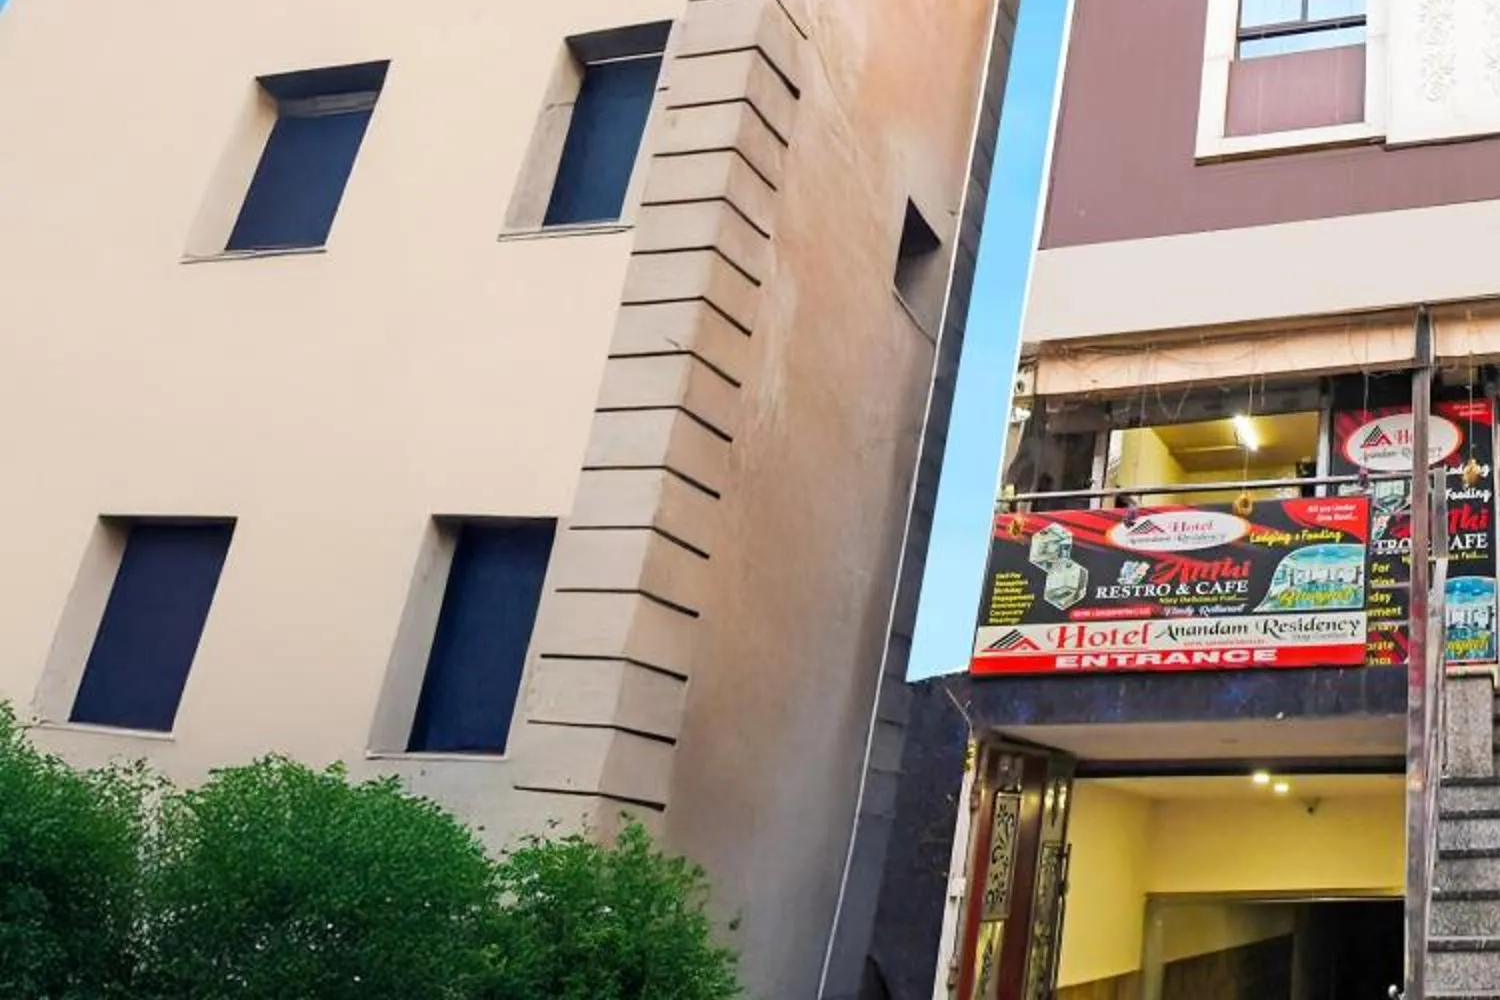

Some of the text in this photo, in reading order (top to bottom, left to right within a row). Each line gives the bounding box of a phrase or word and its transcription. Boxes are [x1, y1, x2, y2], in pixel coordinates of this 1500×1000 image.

[1249, 531, 1292, 546] Lodging
[1095, 579, 1250, 600] RESTRO & CAFE
[1047, 622, 1150, 649] Hotel
[1155, 621, 1249, 641] Anandam
[1256, 616, 1361, 641] Residency
[1055, 648, 1278, 670] ENTRANCE
